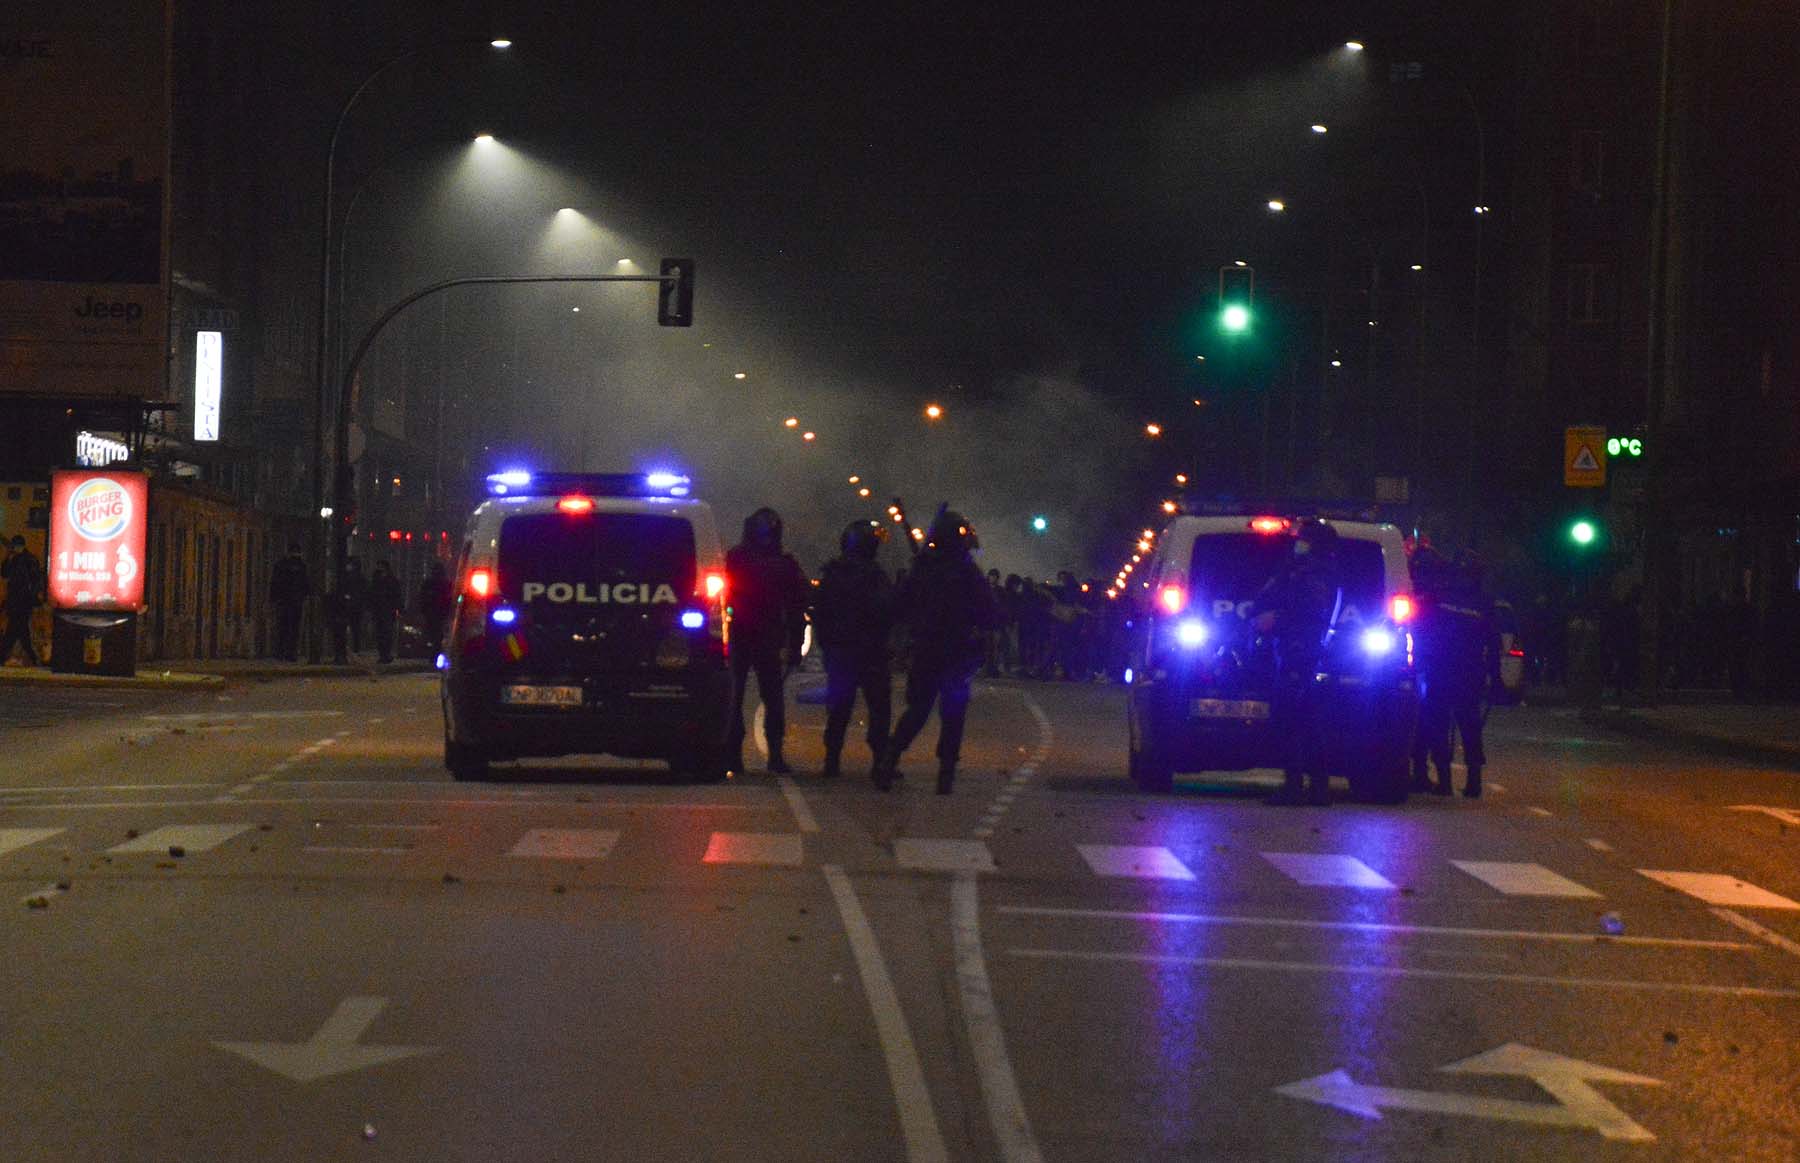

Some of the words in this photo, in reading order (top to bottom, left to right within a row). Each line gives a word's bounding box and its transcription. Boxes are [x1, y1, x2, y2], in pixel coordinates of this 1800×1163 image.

[74, 296, 143, 324] Jeep
[77, 491, 121, 512] BURGER
[80, 502, 124, 526] KING
[58, 551, 68, 569] 1
[73, 551, 106, 570] MIN
[523, 582, 679, 604] POLICIA
